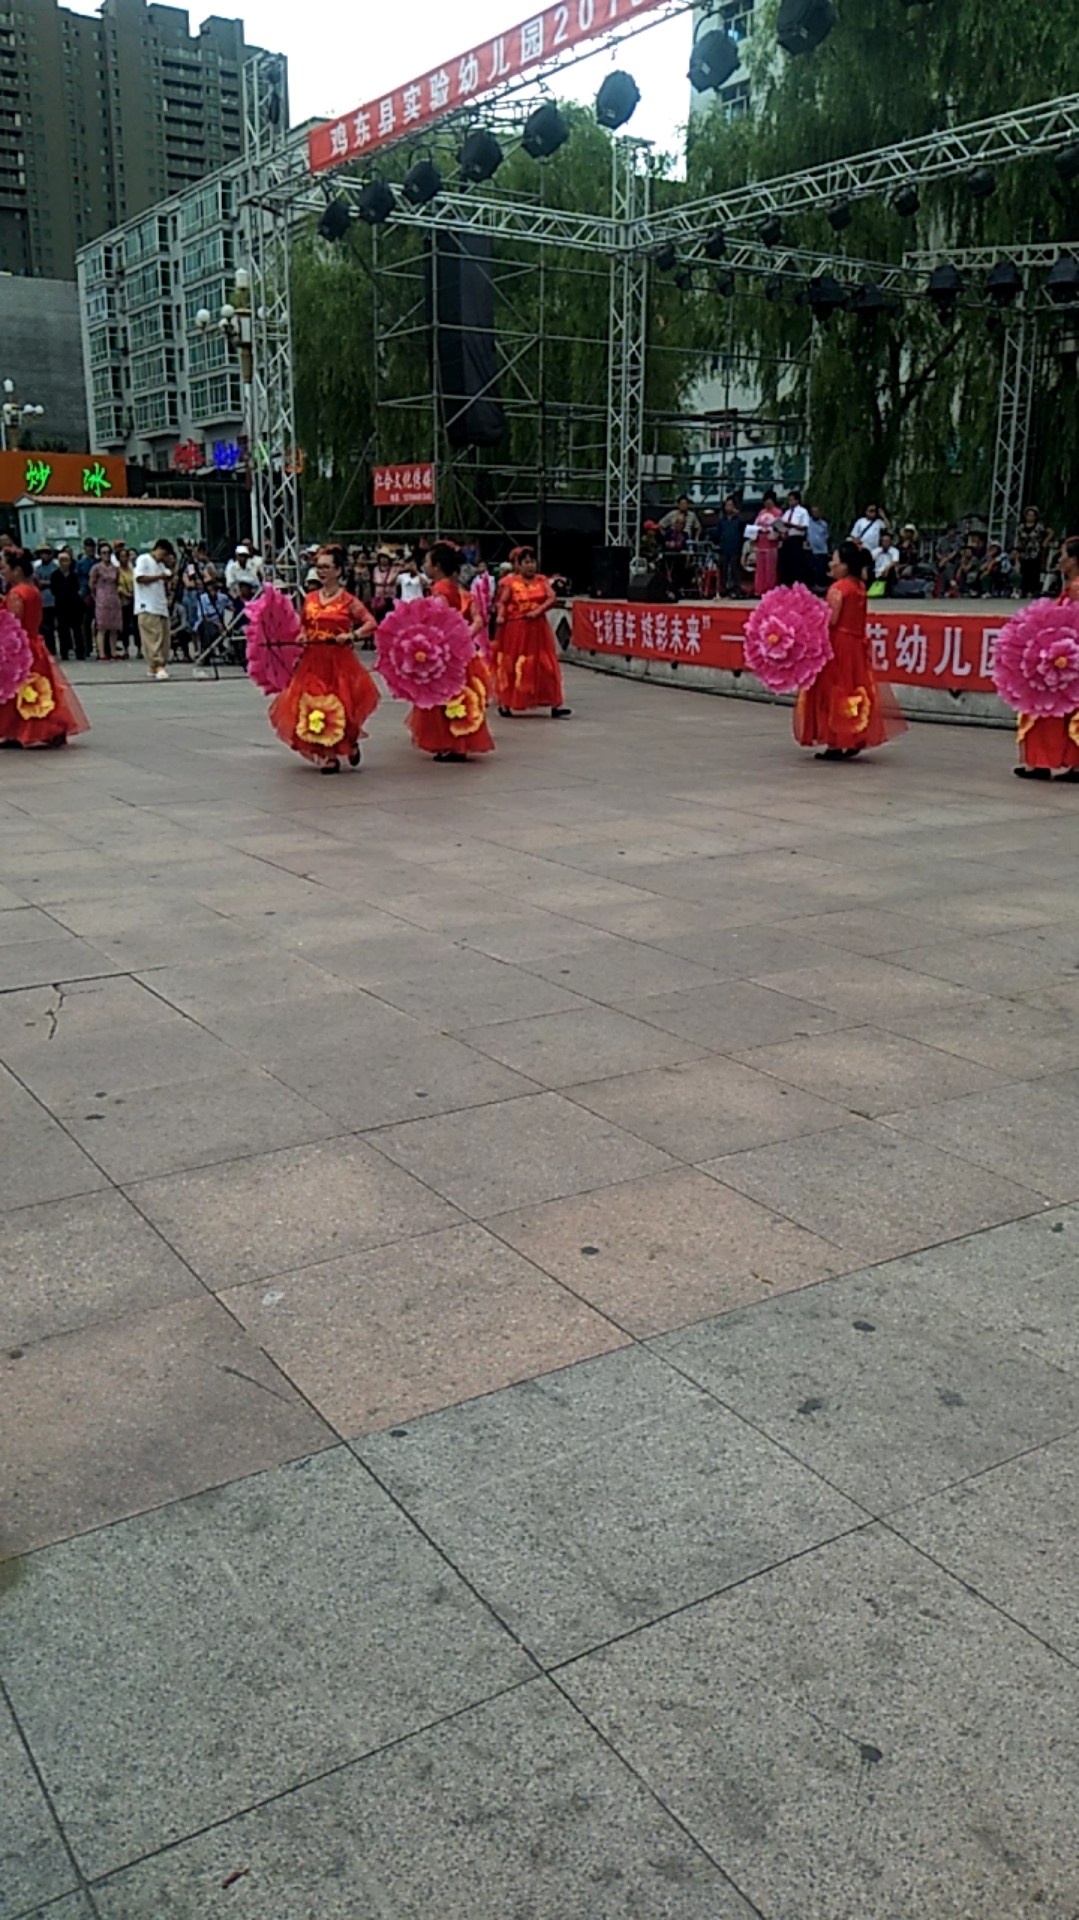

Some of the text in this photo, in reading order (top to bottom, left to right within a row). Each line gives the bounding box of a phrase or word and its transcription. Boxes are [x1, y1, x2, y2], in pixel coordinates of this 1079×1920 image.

[329, 0, 644, 157] 鸡东县实验幼儿园20
